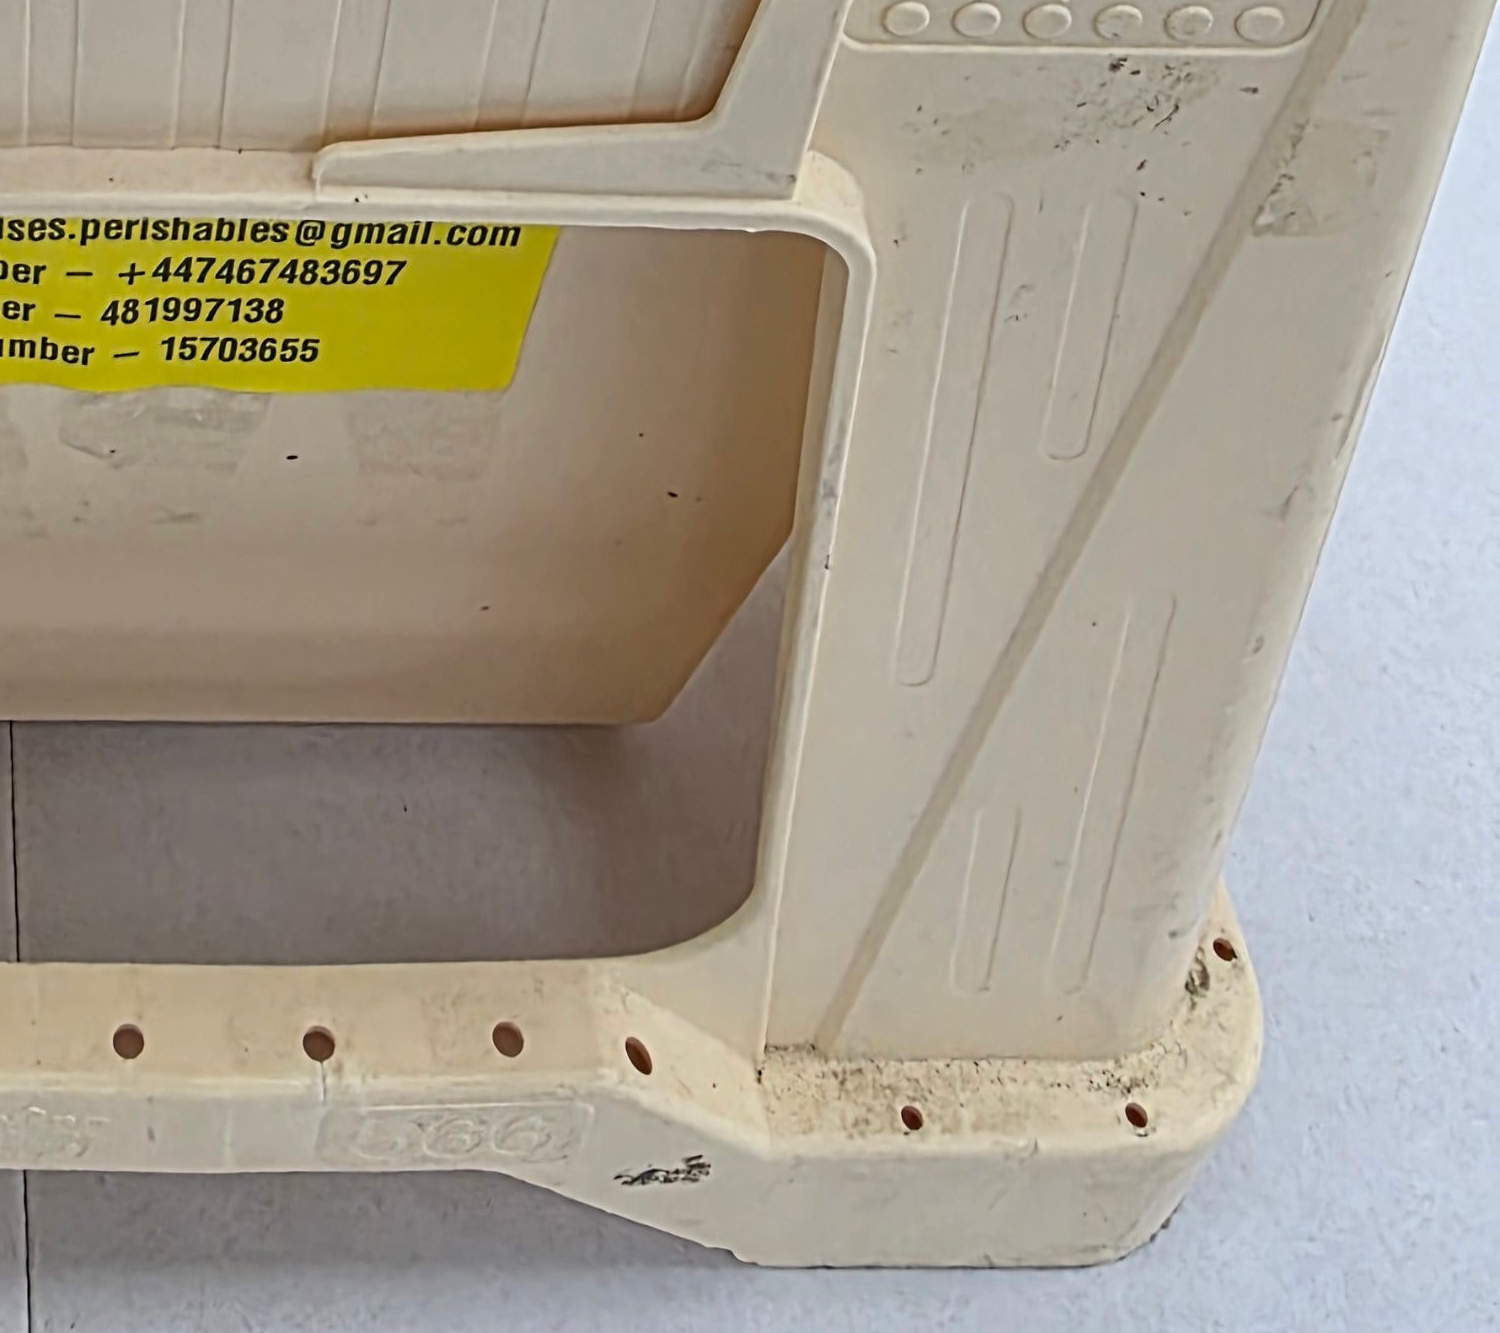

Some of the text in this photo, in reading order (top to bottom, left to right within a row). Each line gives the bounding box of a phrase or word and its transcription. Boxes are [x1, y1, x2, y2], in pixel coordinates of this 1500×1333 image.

[118, 256, 407, 286] +447467483697
[100, 296, 285, 326] 481997138
[161, 336, 320, 363] 15703655
